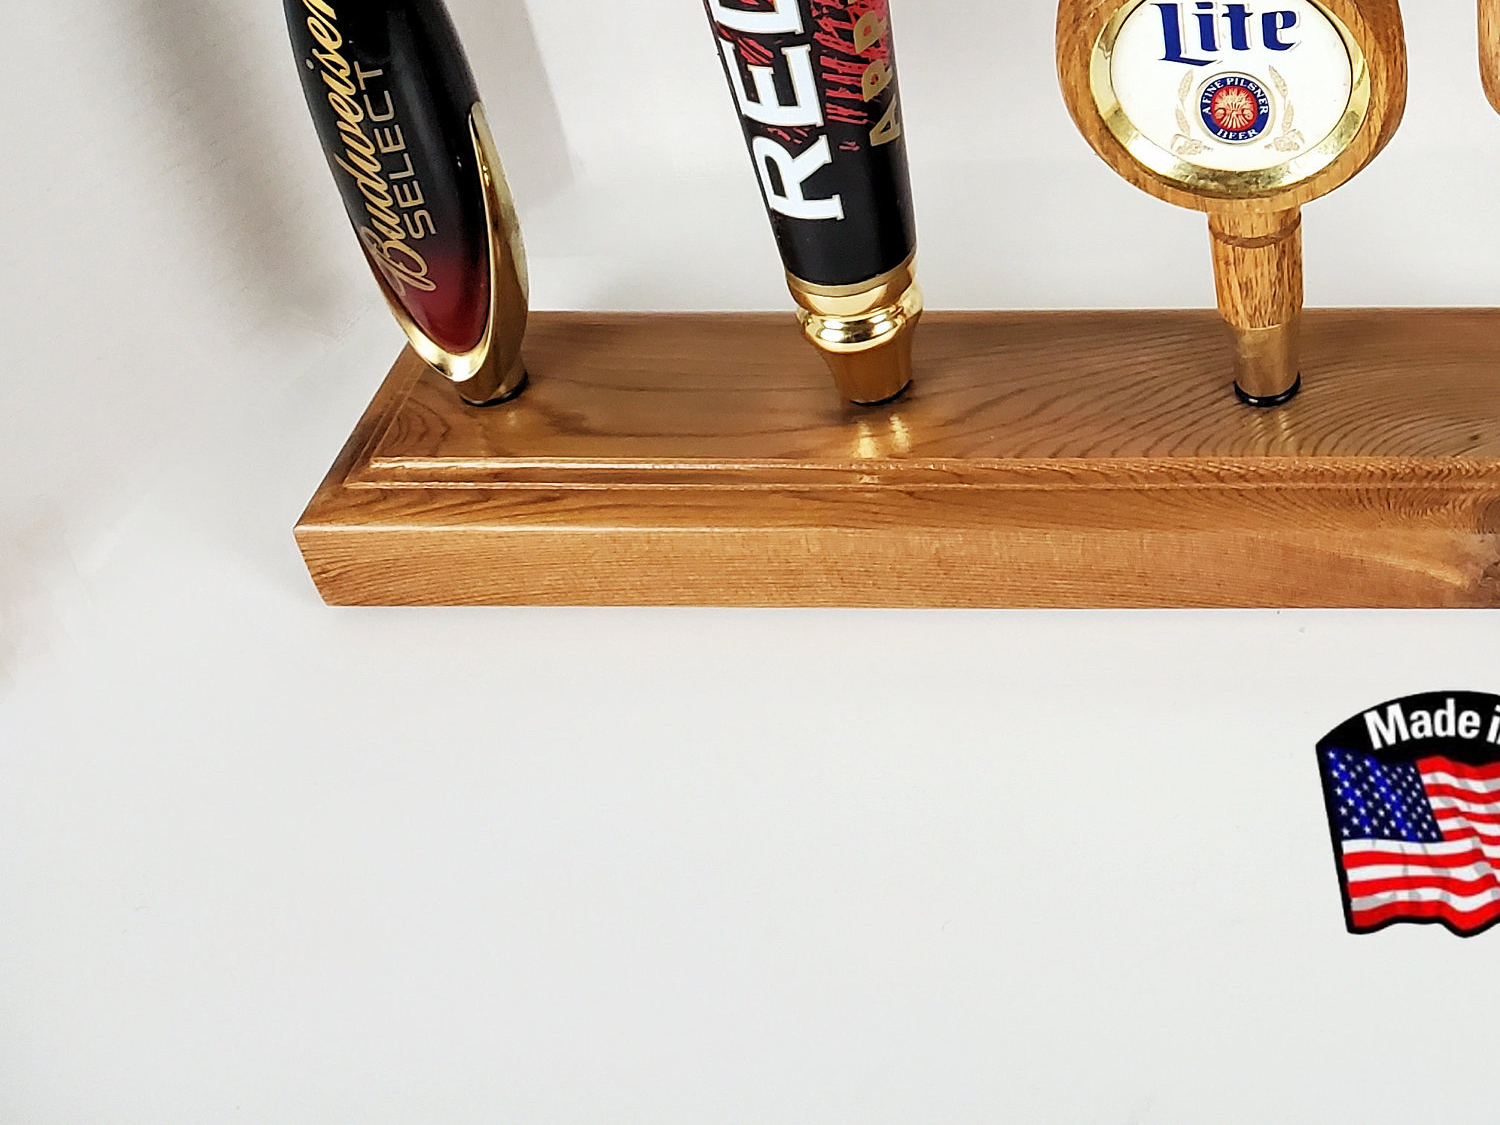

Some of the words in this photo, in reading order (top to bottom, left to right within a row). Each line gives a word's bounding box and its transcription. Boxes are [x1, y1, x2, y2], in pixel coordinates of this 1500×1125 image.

[1150, 1, 1300, 67] Lite
[1202, 79, 1224, 104] FINE
[1226, 77, 1269, 115] PILSNER
[1202, 106, 1212, 115] A
[1216, 128, 1259, 140] BEER
[353, 60, 437, 240] SELECT
